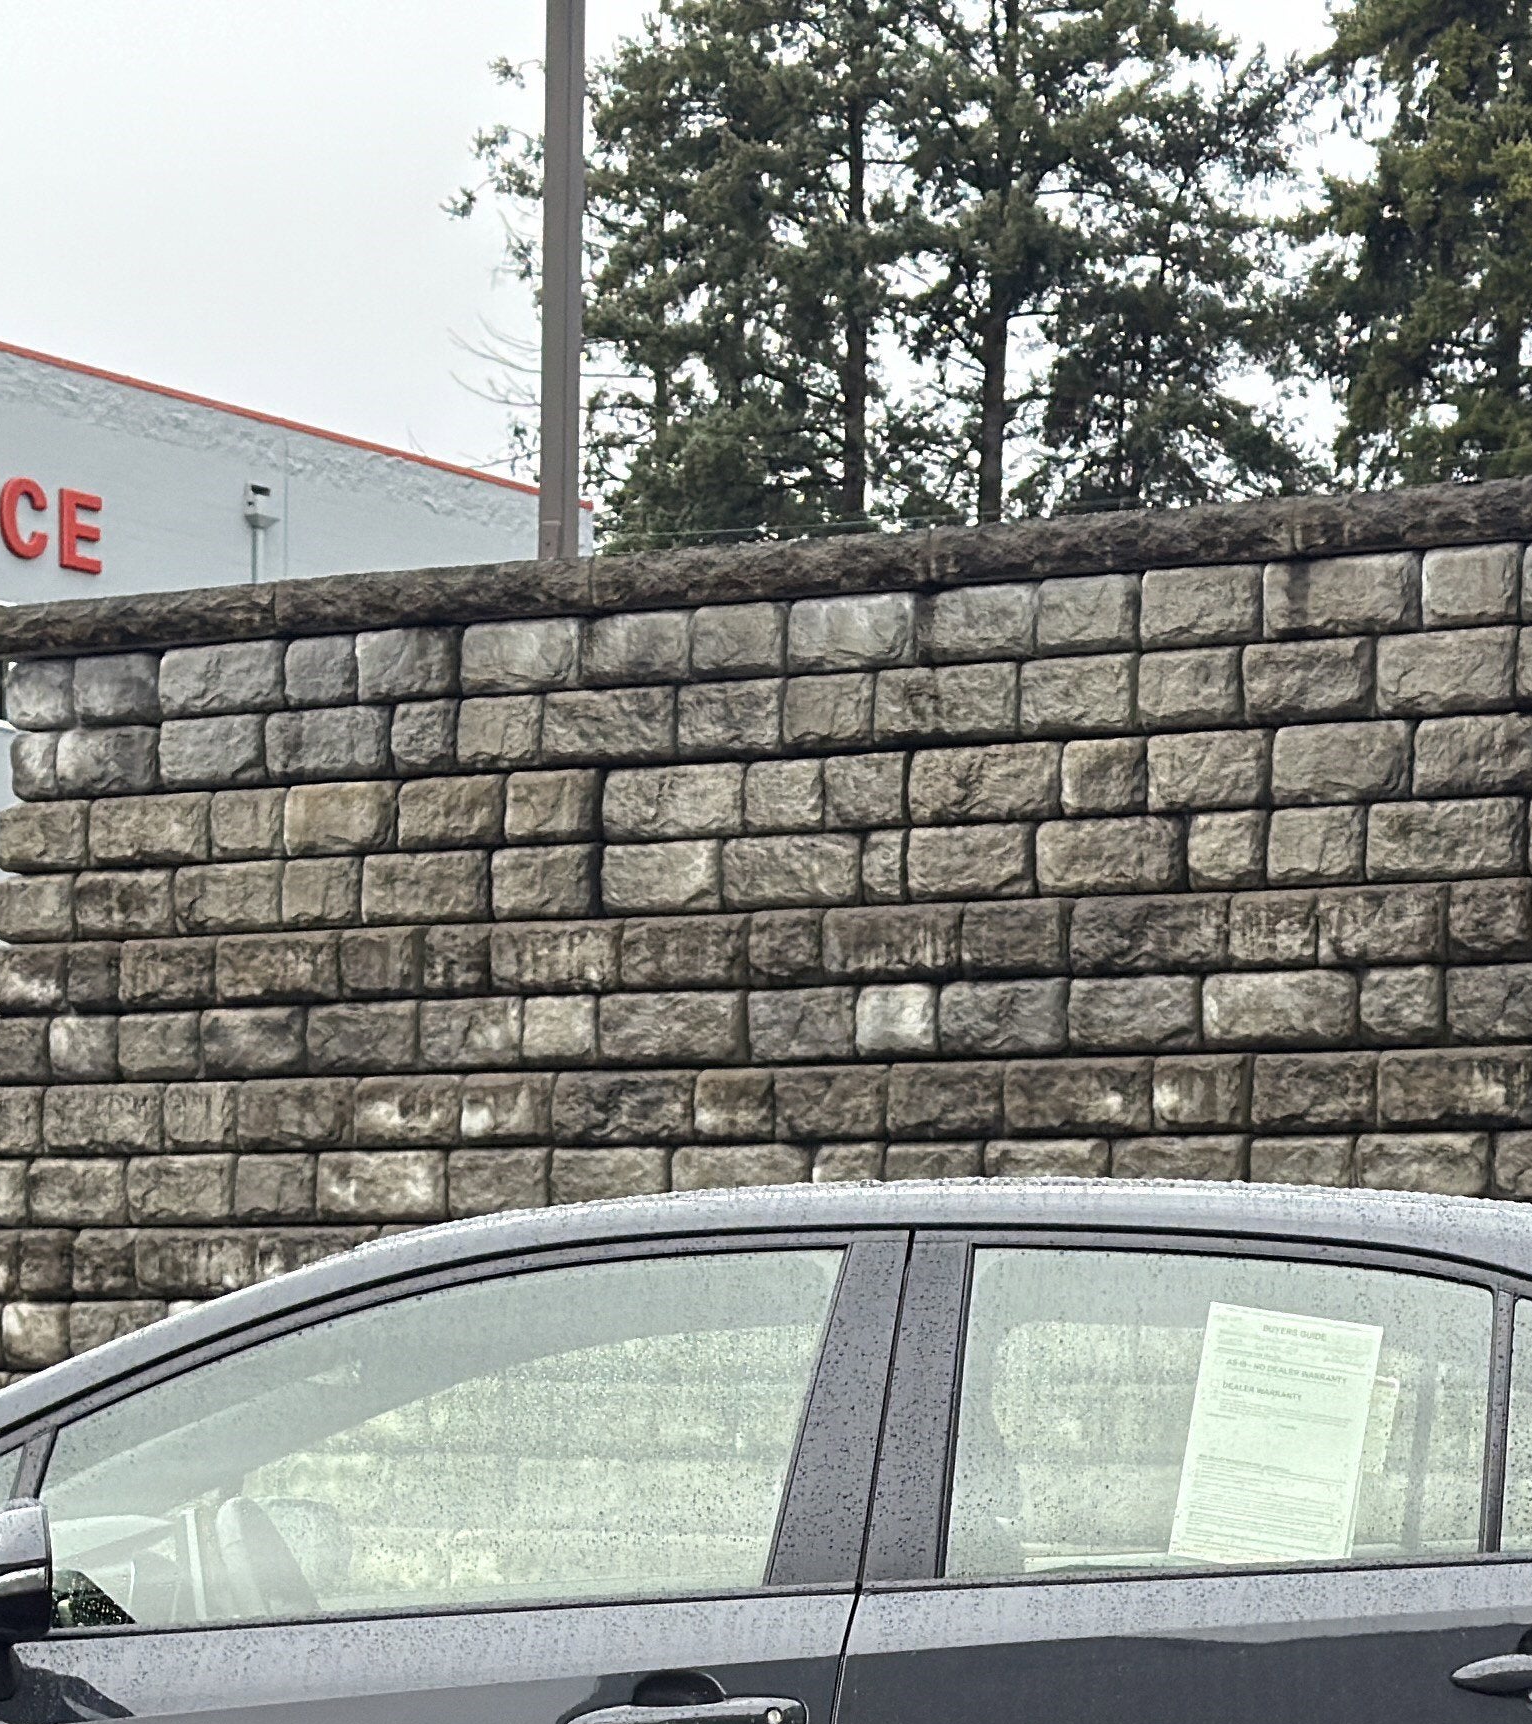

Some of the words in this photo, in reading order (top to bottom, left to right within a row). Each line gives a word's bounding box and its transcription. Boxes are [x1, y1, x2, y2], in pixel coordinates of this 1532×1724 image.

[1263, 1324, 1298, 1337] BUYERS
[1300, 1329, 1327, 1341] GUIDE
[1253, 1363, 1266, 1371] NO
[1267, 1364, 1300, 1377] DEALER
[1301, 1371, 1347, 1384] WARRANTY
[1222, 1380, 1255, 1393] DEALER
[1256, 1387, 1302, 1400] WARRANTY
